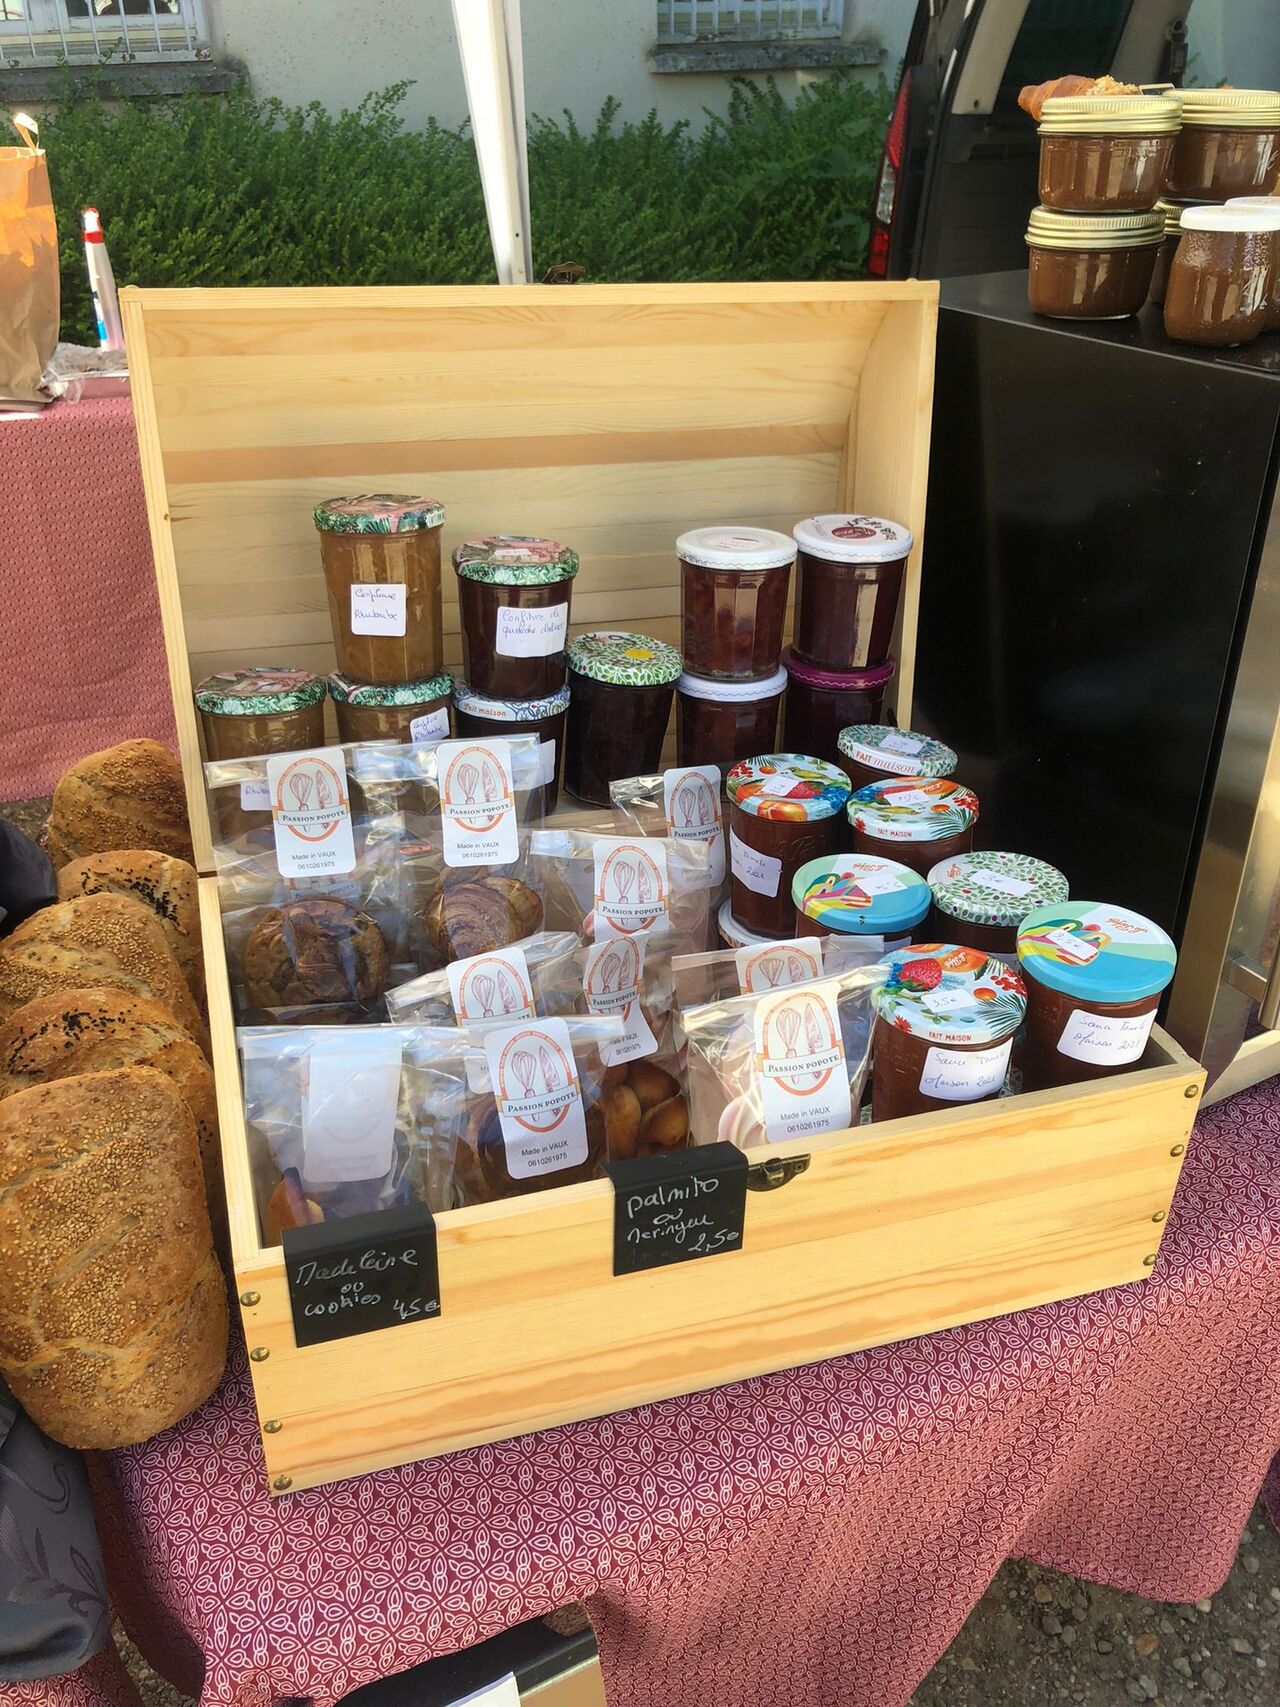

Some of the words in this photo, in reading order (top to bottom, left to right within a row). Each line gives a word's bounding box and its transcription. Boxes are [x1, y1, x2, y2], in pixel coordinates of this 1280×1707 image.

[855, 751, 872, 762] FAIT
[873, 757, 916, 774] maison
[282, 814, 314, 823] PASSION
[316, 809, 346, 821] POPOTE
[449, 808, 481, 816] PASSION
[482, 803, 509, 814] POPOTE
[673, 830, 697, 838] PASSION
[697, 826, 720, 837] POPOTE
[877, 827, 889, 837] FAIT
[890, 829, 913, 838] MAISON
[318, 850, 337, 858] VAUX
[462, 851, 499, 859] 0610261975
[298, 861, 336, 870] 0610261975
[602, 905, 633, 915] PASSION
[634, 907, 664, 915] POPOTE
[927, 1031, 943, 1039] FAIT
[945, 1033, 973, 1041] MAISON
[767, 1063, 804, 1073] PASSION
[805, 1053, 840, 1070] POPOTE
[507, 1102, 544, 1113] PASSION
[545, 1091, 576, 1106] POPOTE
[780, 1112, 800, 1121] Made
[809, 1105, 831, 1116] VAUX
[786, 1118, 831, 1134] 0610261975
[521, 1148, 541, 1157] Made
[548, 1139, 569, 1151] VAUX
[527, 1152, 568, 1168] 0610261975
